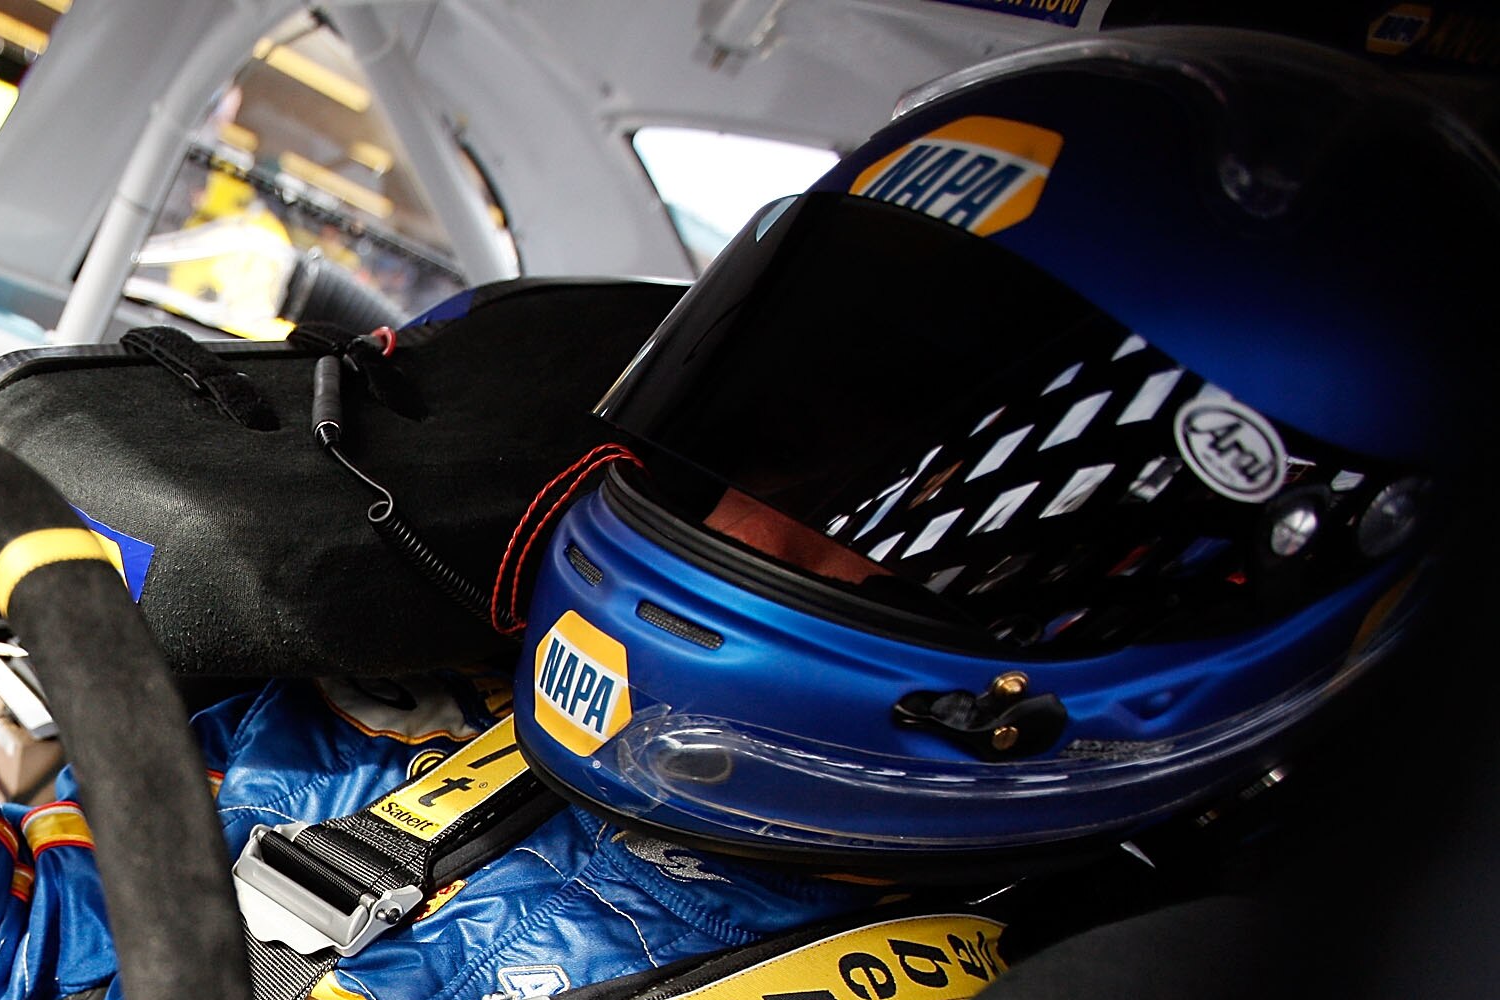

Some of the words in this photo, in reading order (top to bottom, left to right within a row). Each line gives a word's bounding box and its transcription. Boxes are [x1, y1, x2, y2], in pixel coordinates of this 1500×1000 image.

[863, 145, 1026, 229] NAPA
[1187, 420, 1272, 483] Arai
[539, 637, 615, 734] NAPA
[381, 802, 434, 832] Sabelt
